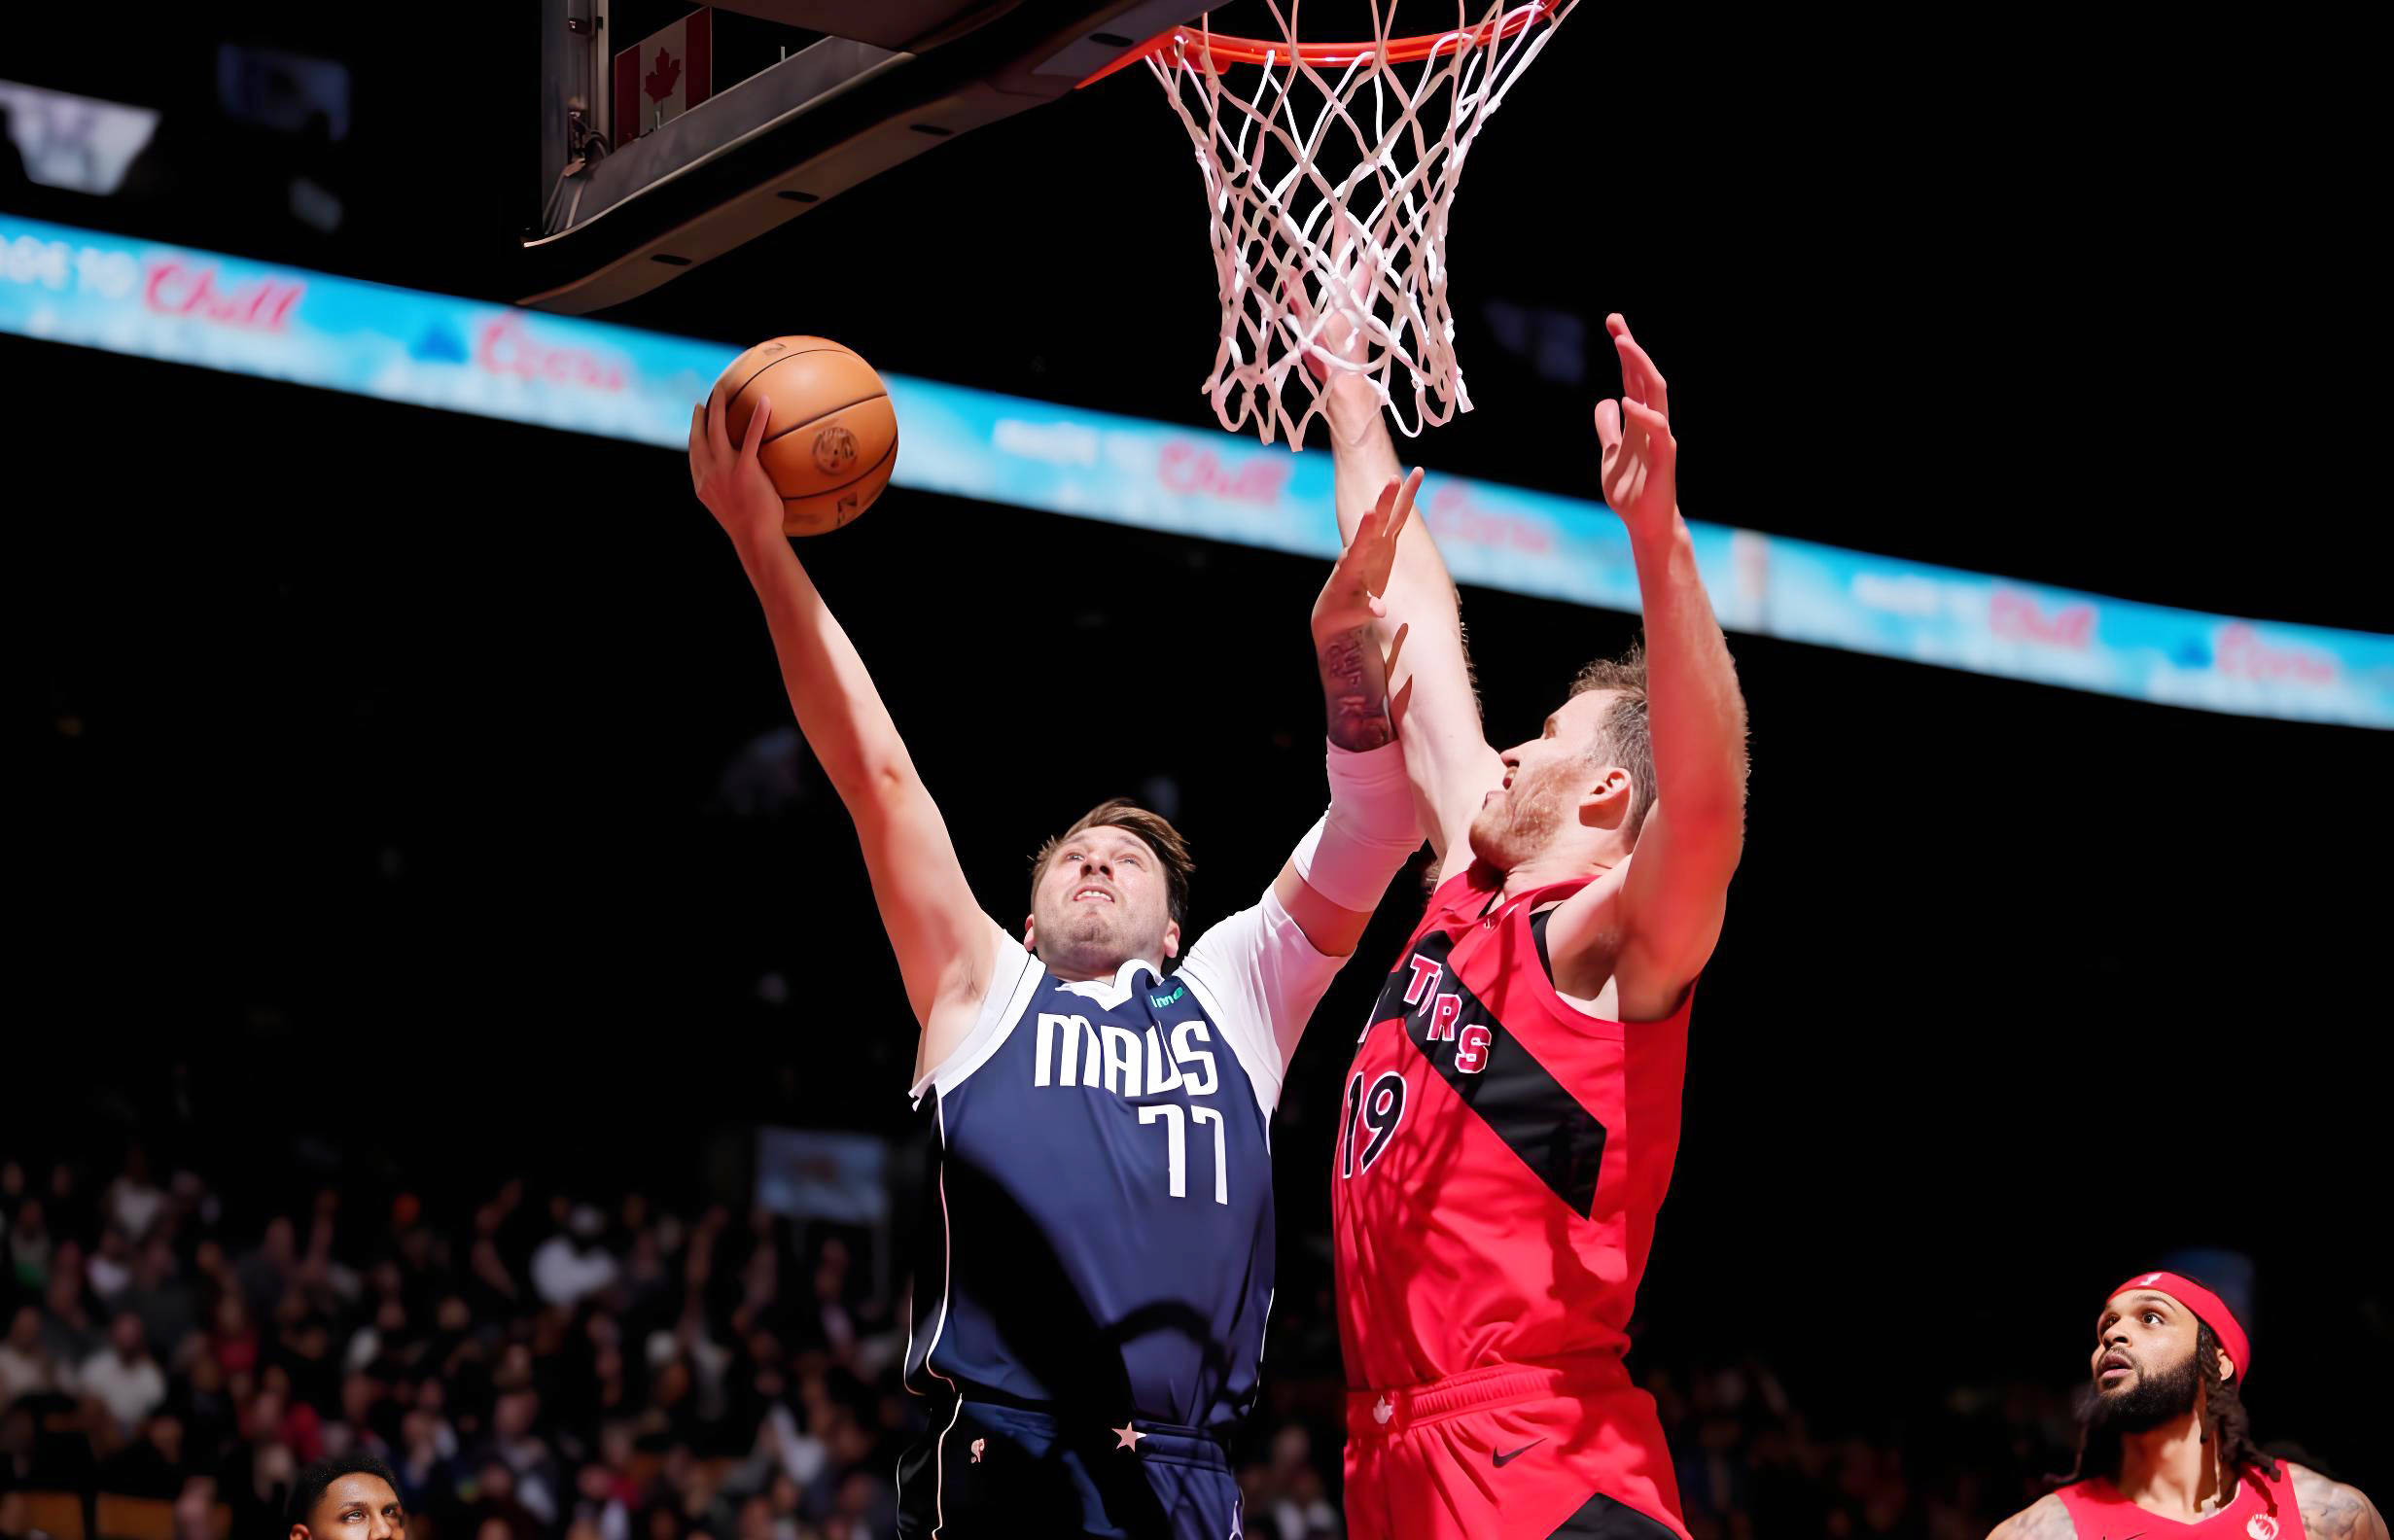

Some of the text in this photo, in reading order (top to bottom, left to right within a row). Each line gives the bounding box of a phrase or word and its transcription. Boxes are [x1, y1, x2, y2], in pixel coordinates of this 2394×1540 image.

[145, 261, 304, 332] Chill
[1035, 1012, 1219, 1098] MAVS
[1138, 1103, 1229, 1206] 77
[1342, 1070, 1407, 1179] 19
